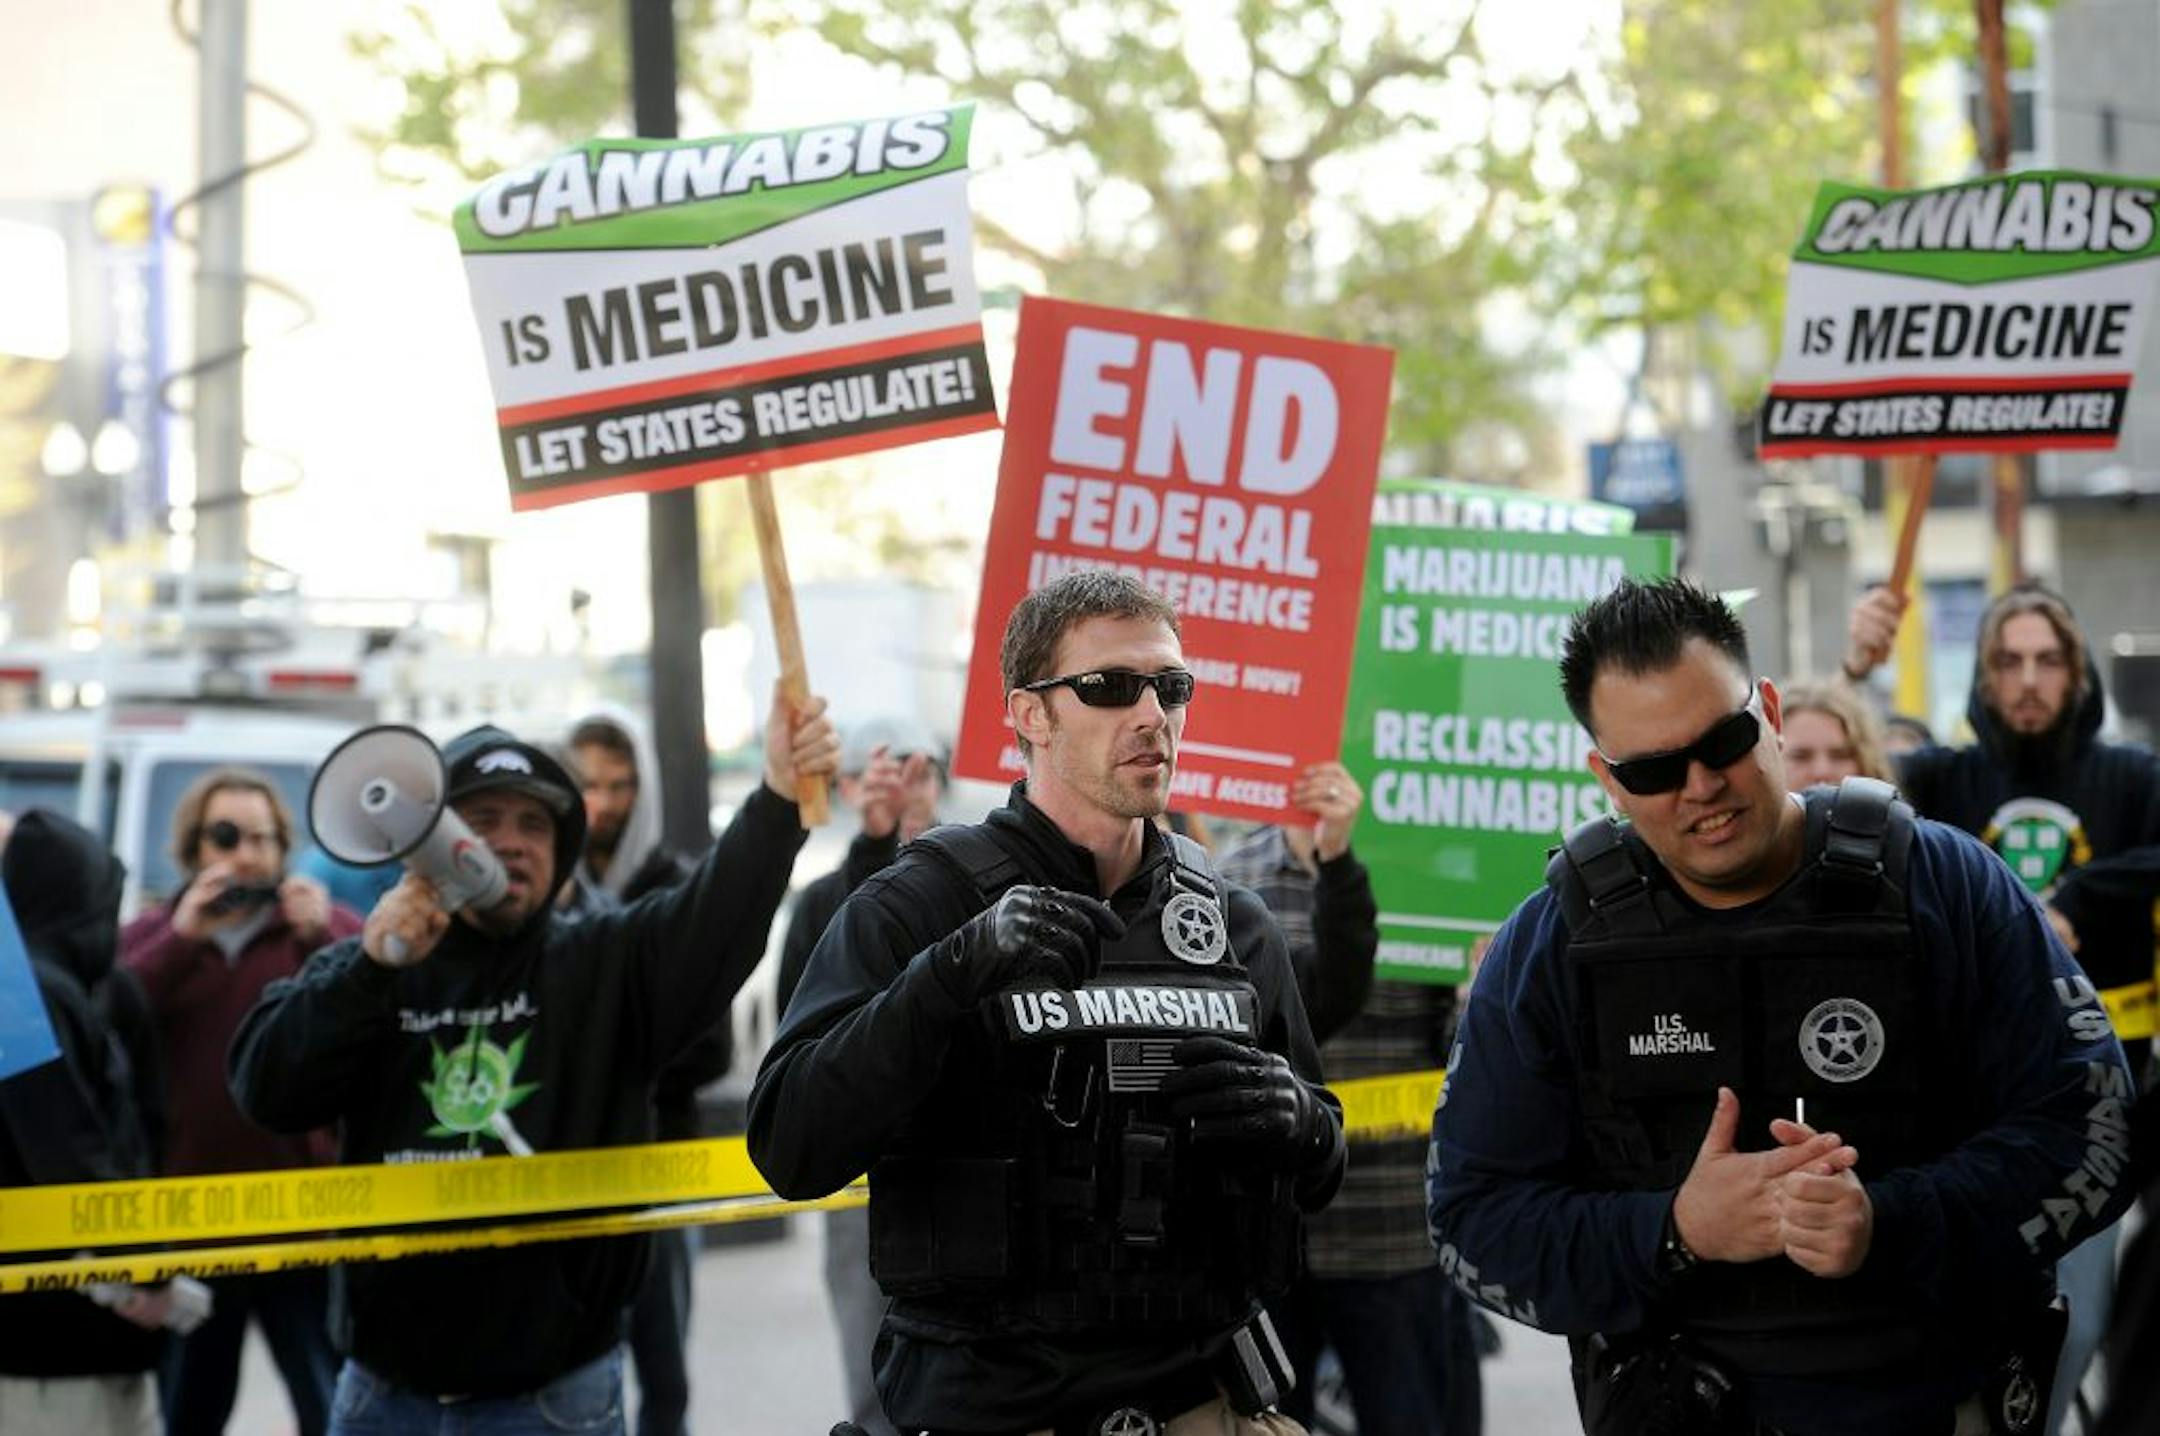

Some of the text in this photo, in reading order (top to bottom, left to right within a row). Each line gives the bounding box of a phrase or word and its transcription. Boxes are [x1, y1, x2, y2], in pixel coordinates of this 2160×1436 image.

[473, 111, 951, 237] CANNABIS
[1816, 180, 2154, 253] CANNABIS
[502, 229, 954, 371] IS MEDICINE
[1802, 303, 2131, 363] IS MEDICINE
[515, 357, 976, 479] LET STATES REGULATE!
[1049, 326, 1340, 497] END
[1768, 393, 2115, 435] LET STATES REGULATE!
[1036, 473, 1319, 579] FEDERAL
[1028, 552, 1314, 632] INFERENCE
[1383, 545, 1627, 601] MARIJUANA
[1380, 606, 1570, 658] IS MEDIC
[1012, 988, 1249, 1033] US MARSHAL
[1629, 1031, 1716, 1056] MARSHAL
[1654, 1012, 1687, 1034] U.S.
[2018, 975, 2130, 1255] US MARSHAL
